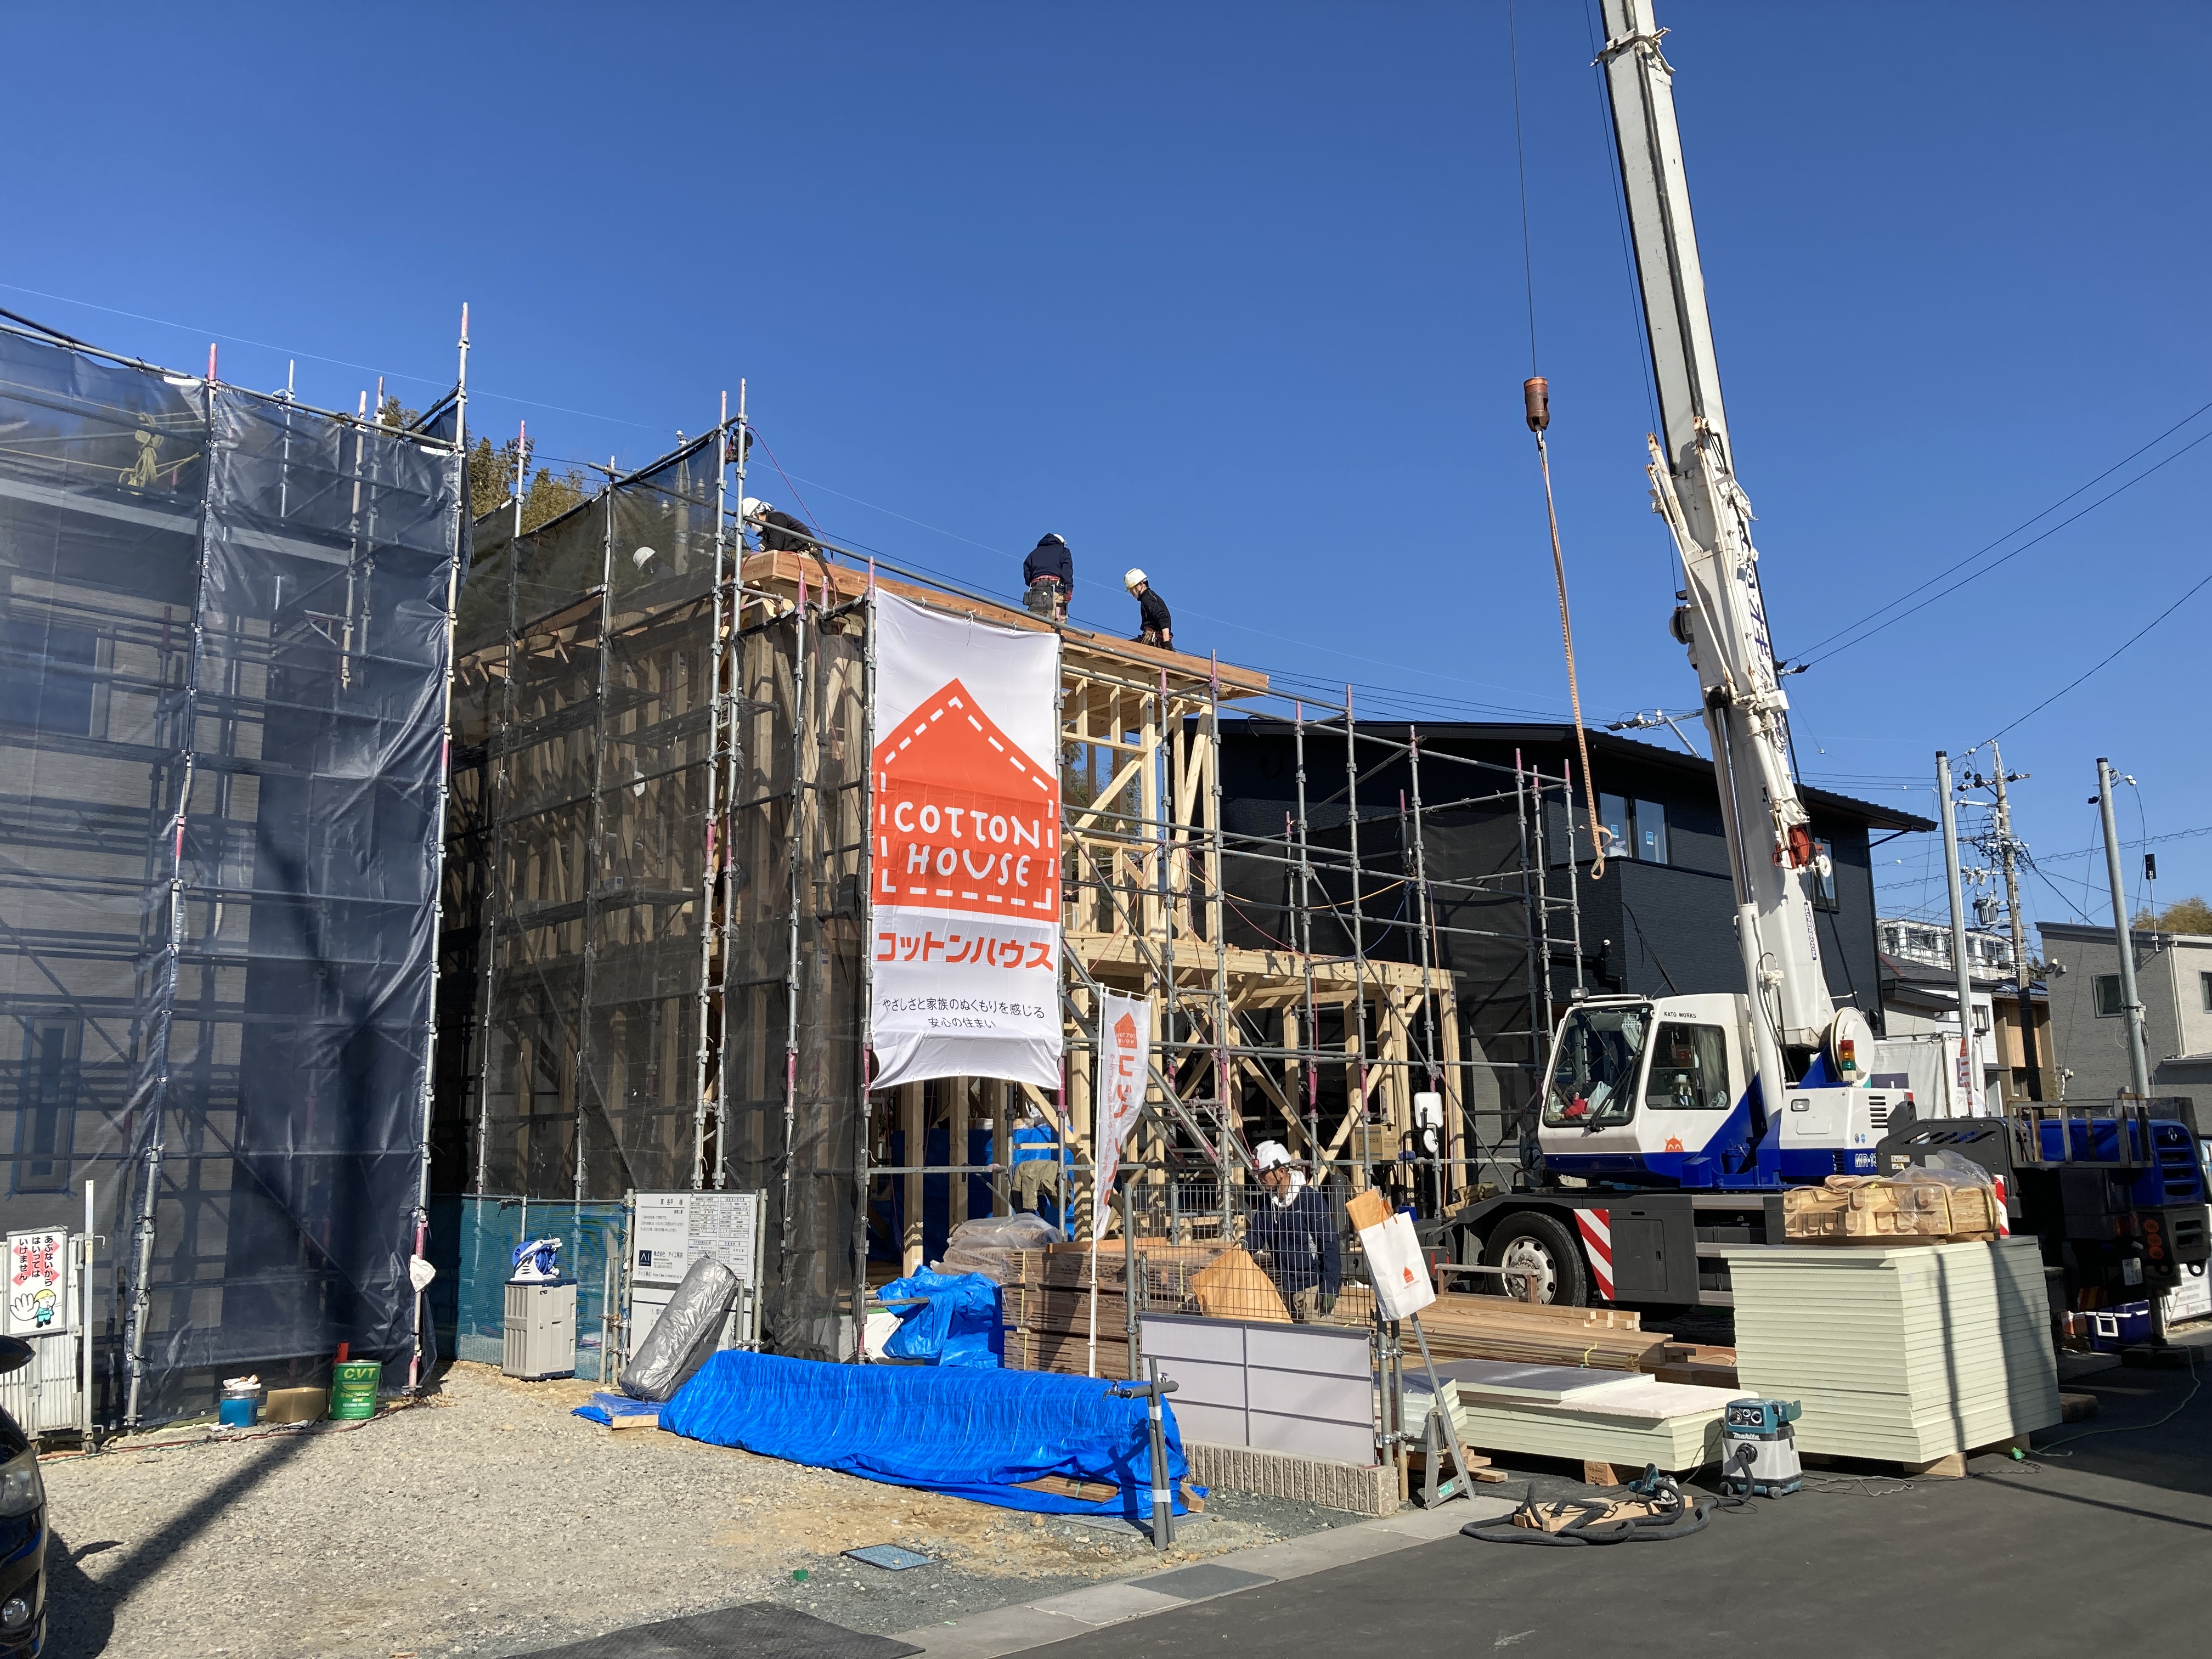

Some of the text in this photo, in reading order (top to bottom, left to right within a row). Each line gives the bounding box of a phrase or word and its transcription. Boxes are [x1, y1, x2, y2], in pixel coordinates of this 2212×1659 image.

[894, 801, 1040, 849] COTTON
[907, 843, 1031, 887] HOUSE
[877, 931, 1053, 972] コットンハウス
[883, 997, 1045, 1019] やさしさと家族のぬくもりを感じる
[928, 1016, 996, 1029] 安心の住まい
[19, 1238, 29, 1281] いけません
[32, 1236, 41, 1278] はいっては
[44, 1235, 53, 1286] あぶないから
[344, 1368, 376, 1379] CVT
